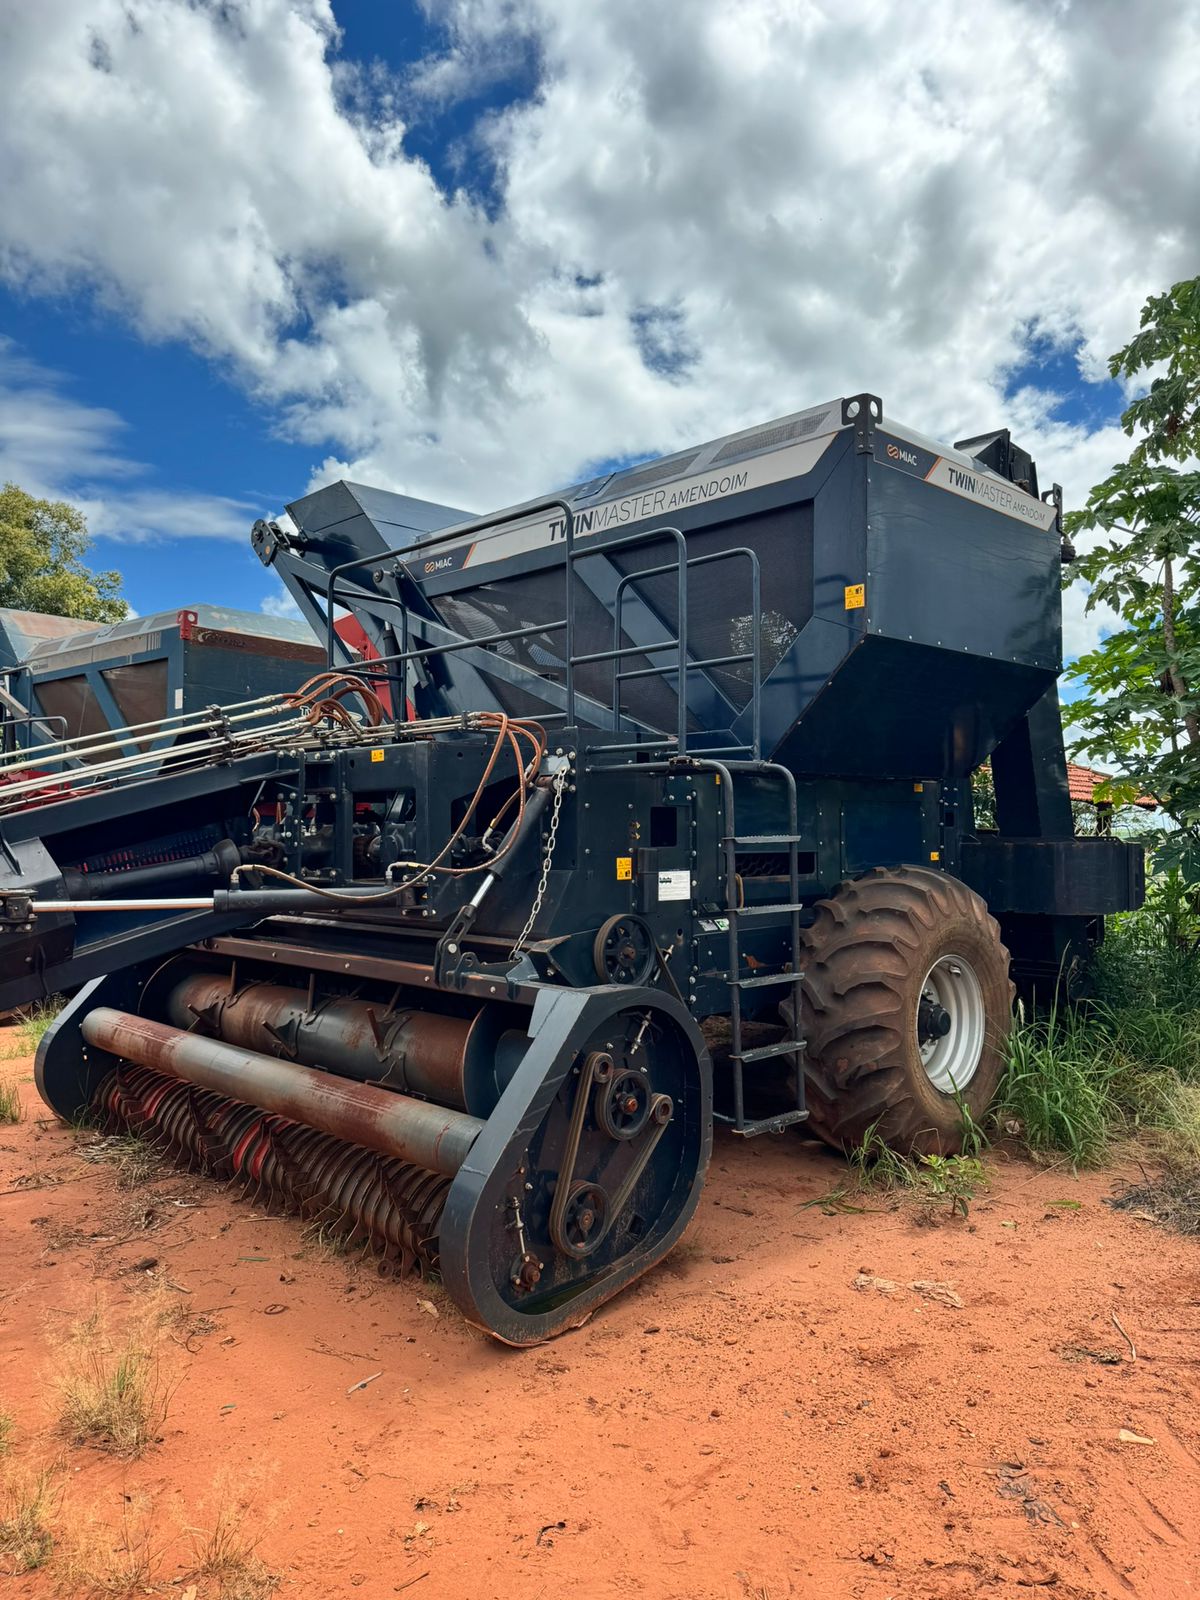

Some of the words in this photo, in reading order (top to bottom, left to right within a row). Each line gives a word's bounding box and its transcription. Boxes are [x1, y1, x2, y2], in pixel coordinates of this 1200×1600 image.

[899, 450, 917, 466] MIAC
[548, 490, 665, 542] TWINMASTER
[667, 471, 748, 508] AMENDOIM
[948, 467, 1012, 509] TWINMASTER
[1013, 503, 1046, 522] AMENDOIM
[435, 557, 453, 571] MIAC
